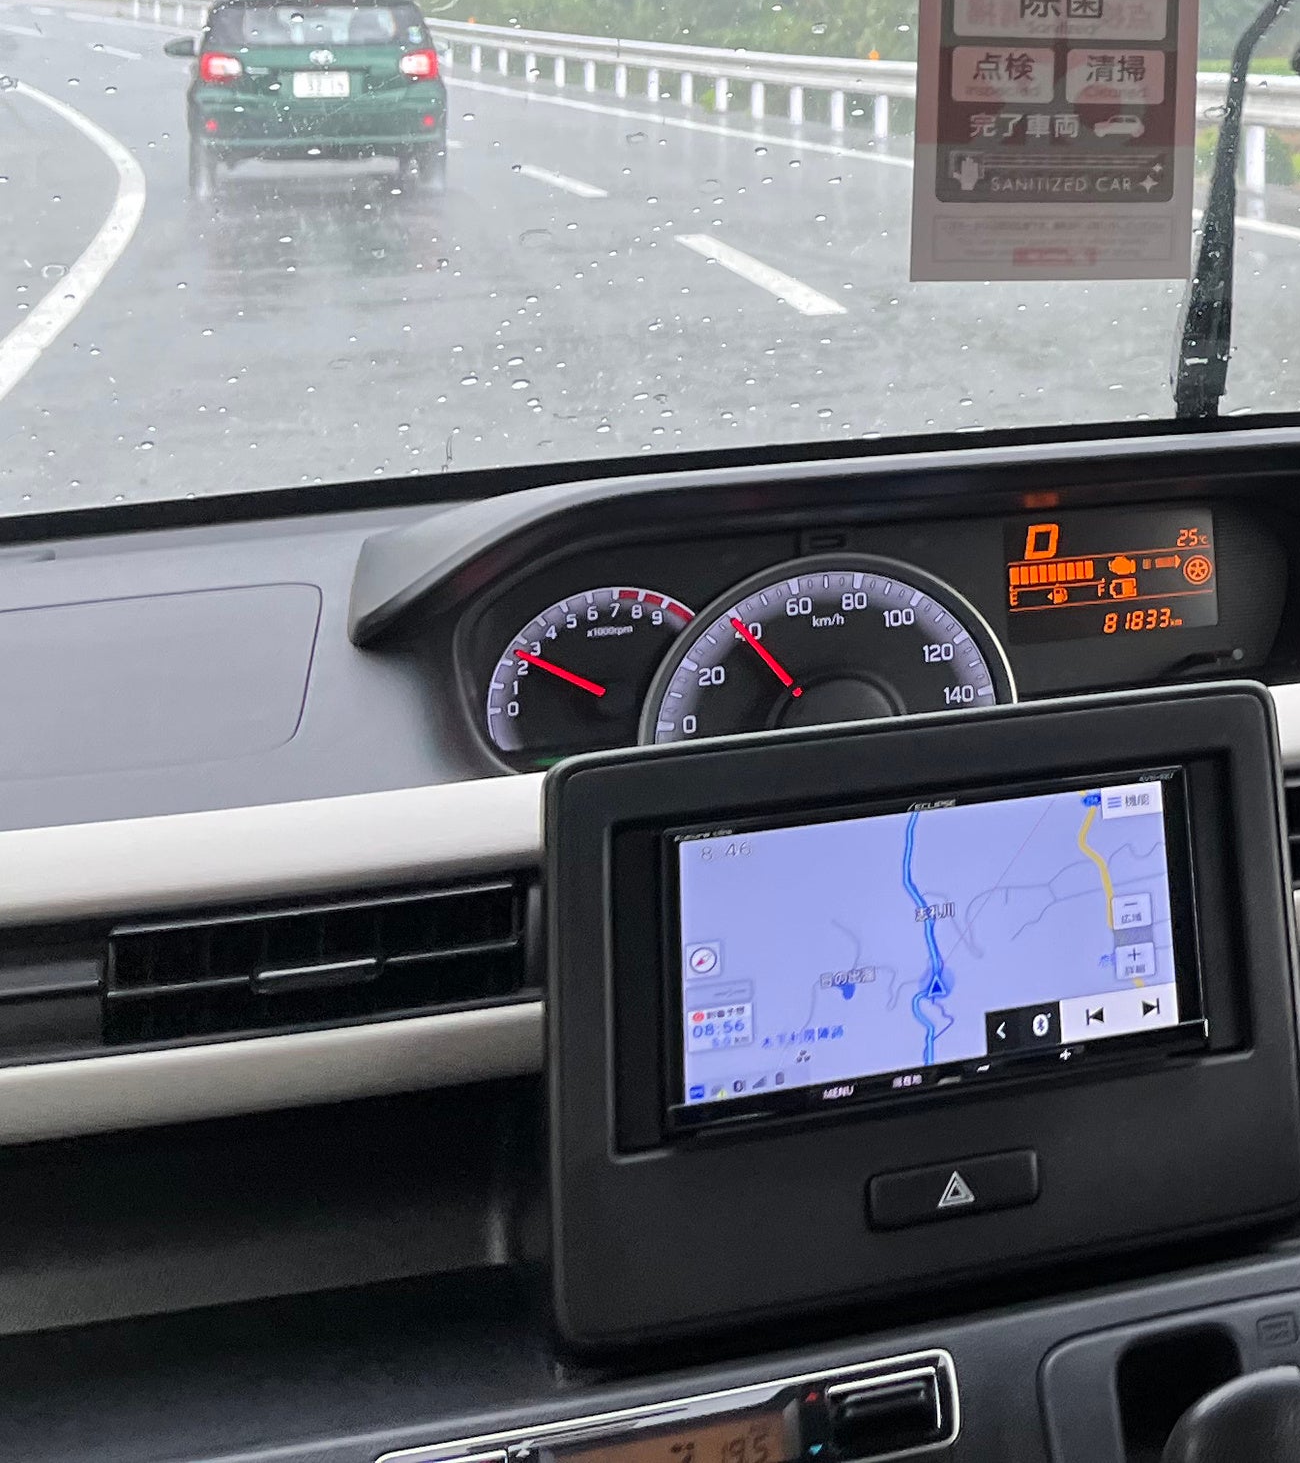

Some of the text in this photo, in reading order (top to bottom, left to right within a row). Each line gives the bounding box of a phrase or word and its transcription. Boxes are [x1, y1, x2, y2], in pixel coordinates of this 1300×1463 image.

[972, 52, 1036, 81] 点検
[1086, 55, 1146, 83] 清掃
[969, 113, 1080, 139] 完了車両
[991, 176, 1132, 193] SANITIZED CAR
[841, 591, 868, 611] 80
[1009, 585, 1019, 607] E
[586, 605, 599, 621] 6
[609, 602, 621, 618] 7
[631, 604, 643, 620] 8
[785, 596, 813, 616] 60
[566, 613, 578, 629] 5
[651, 610, 663, 626] 9
[812, 614, 845, 628] km/h
[883, 608, 915, 628] 100
[545, 625, 558, 640] 4
[530, 641, 542, 657] 3
[923, 643, 955, 663] 120
[517, 660, 528, 676] 2
[698, 665, 725, 687] 20
[512, 680, 519, 695] 1
[943, 684, 975, 705] 140
[507, 701, 520, 717] 0
[682, 714, 697, 735] 0
[692, 1019, 746, 1039] 08:56
[822, 1084, 856, 1100] MENU
